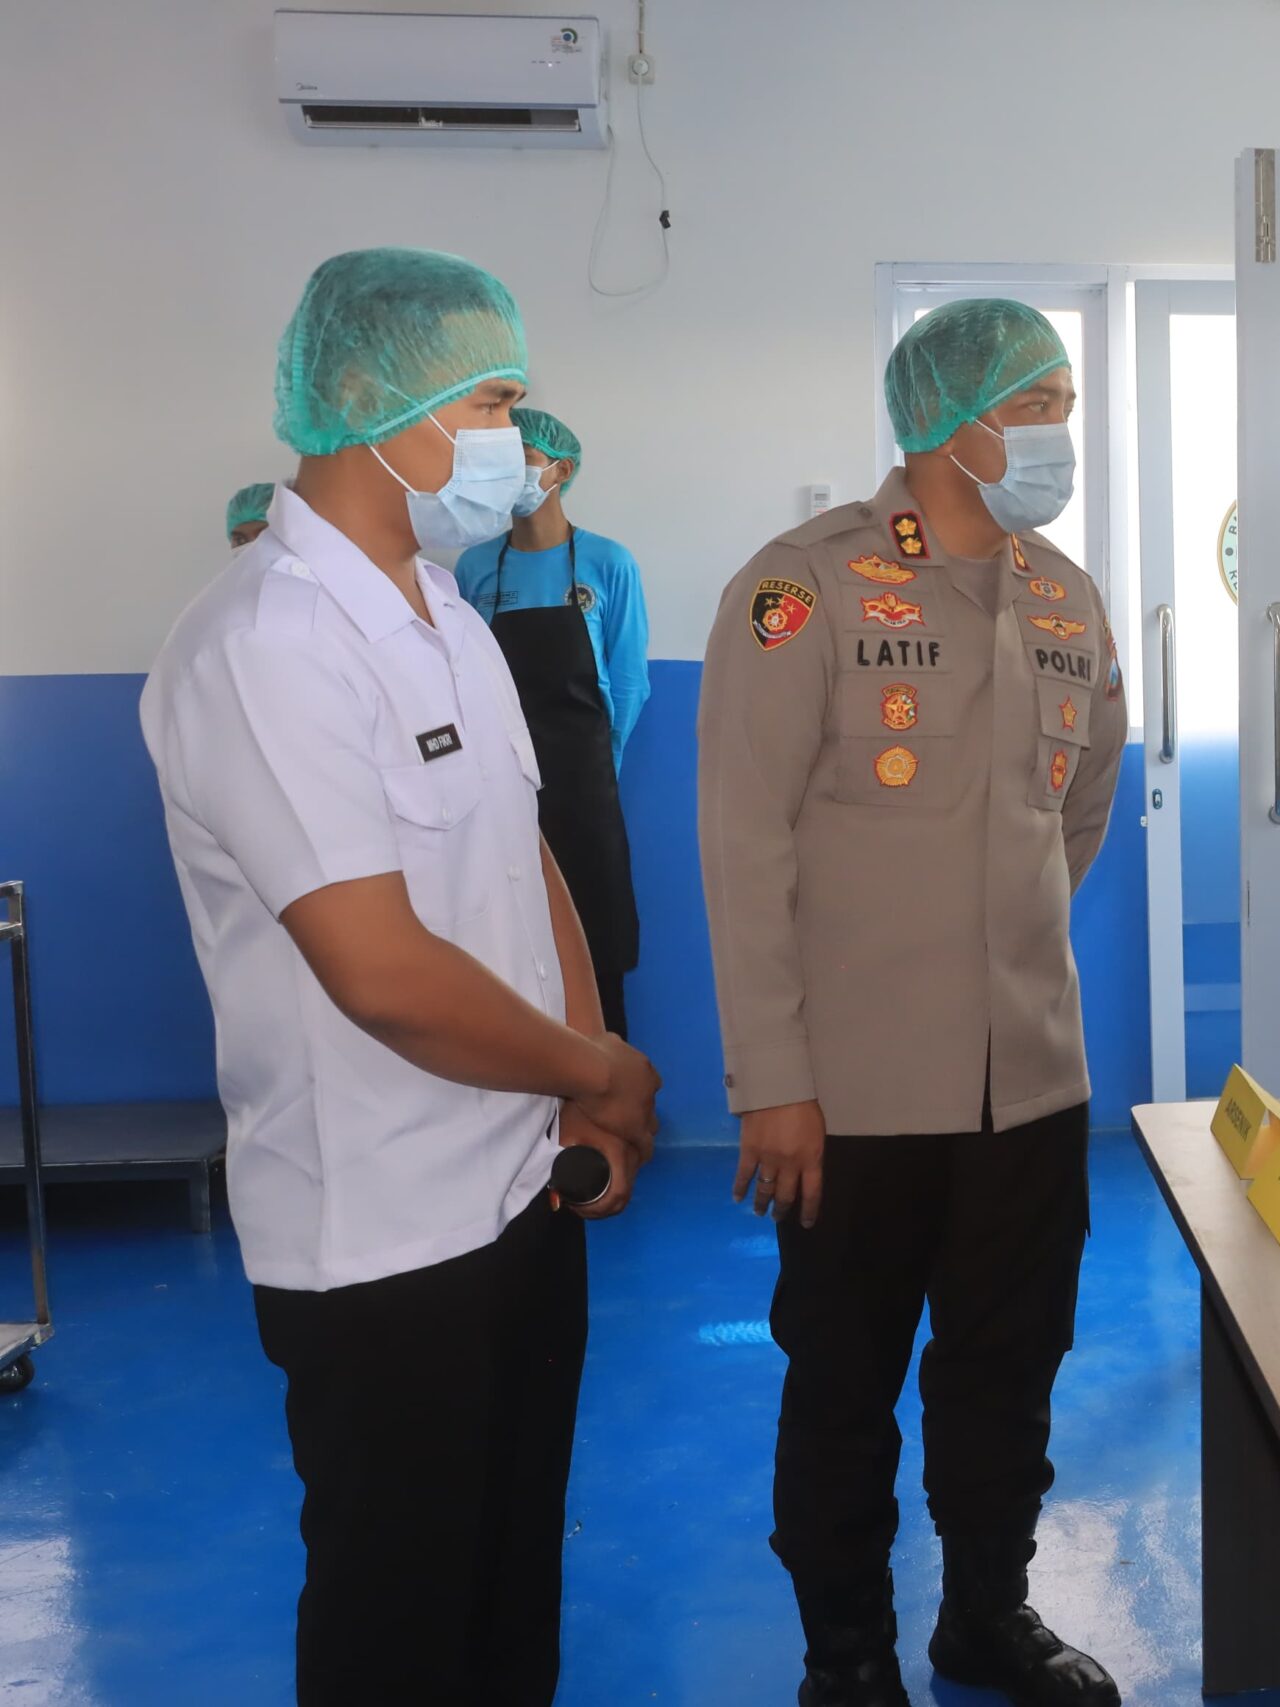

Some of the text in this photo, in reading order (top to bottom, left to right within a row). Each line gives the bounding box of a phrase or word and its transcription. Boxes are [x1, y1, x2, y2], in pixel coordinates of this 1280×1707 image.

[761, 581, 813, 604] RESERSE
[857, 638, 940, 667] LATIF
[1034, 648, 1091, 682] POLRI
